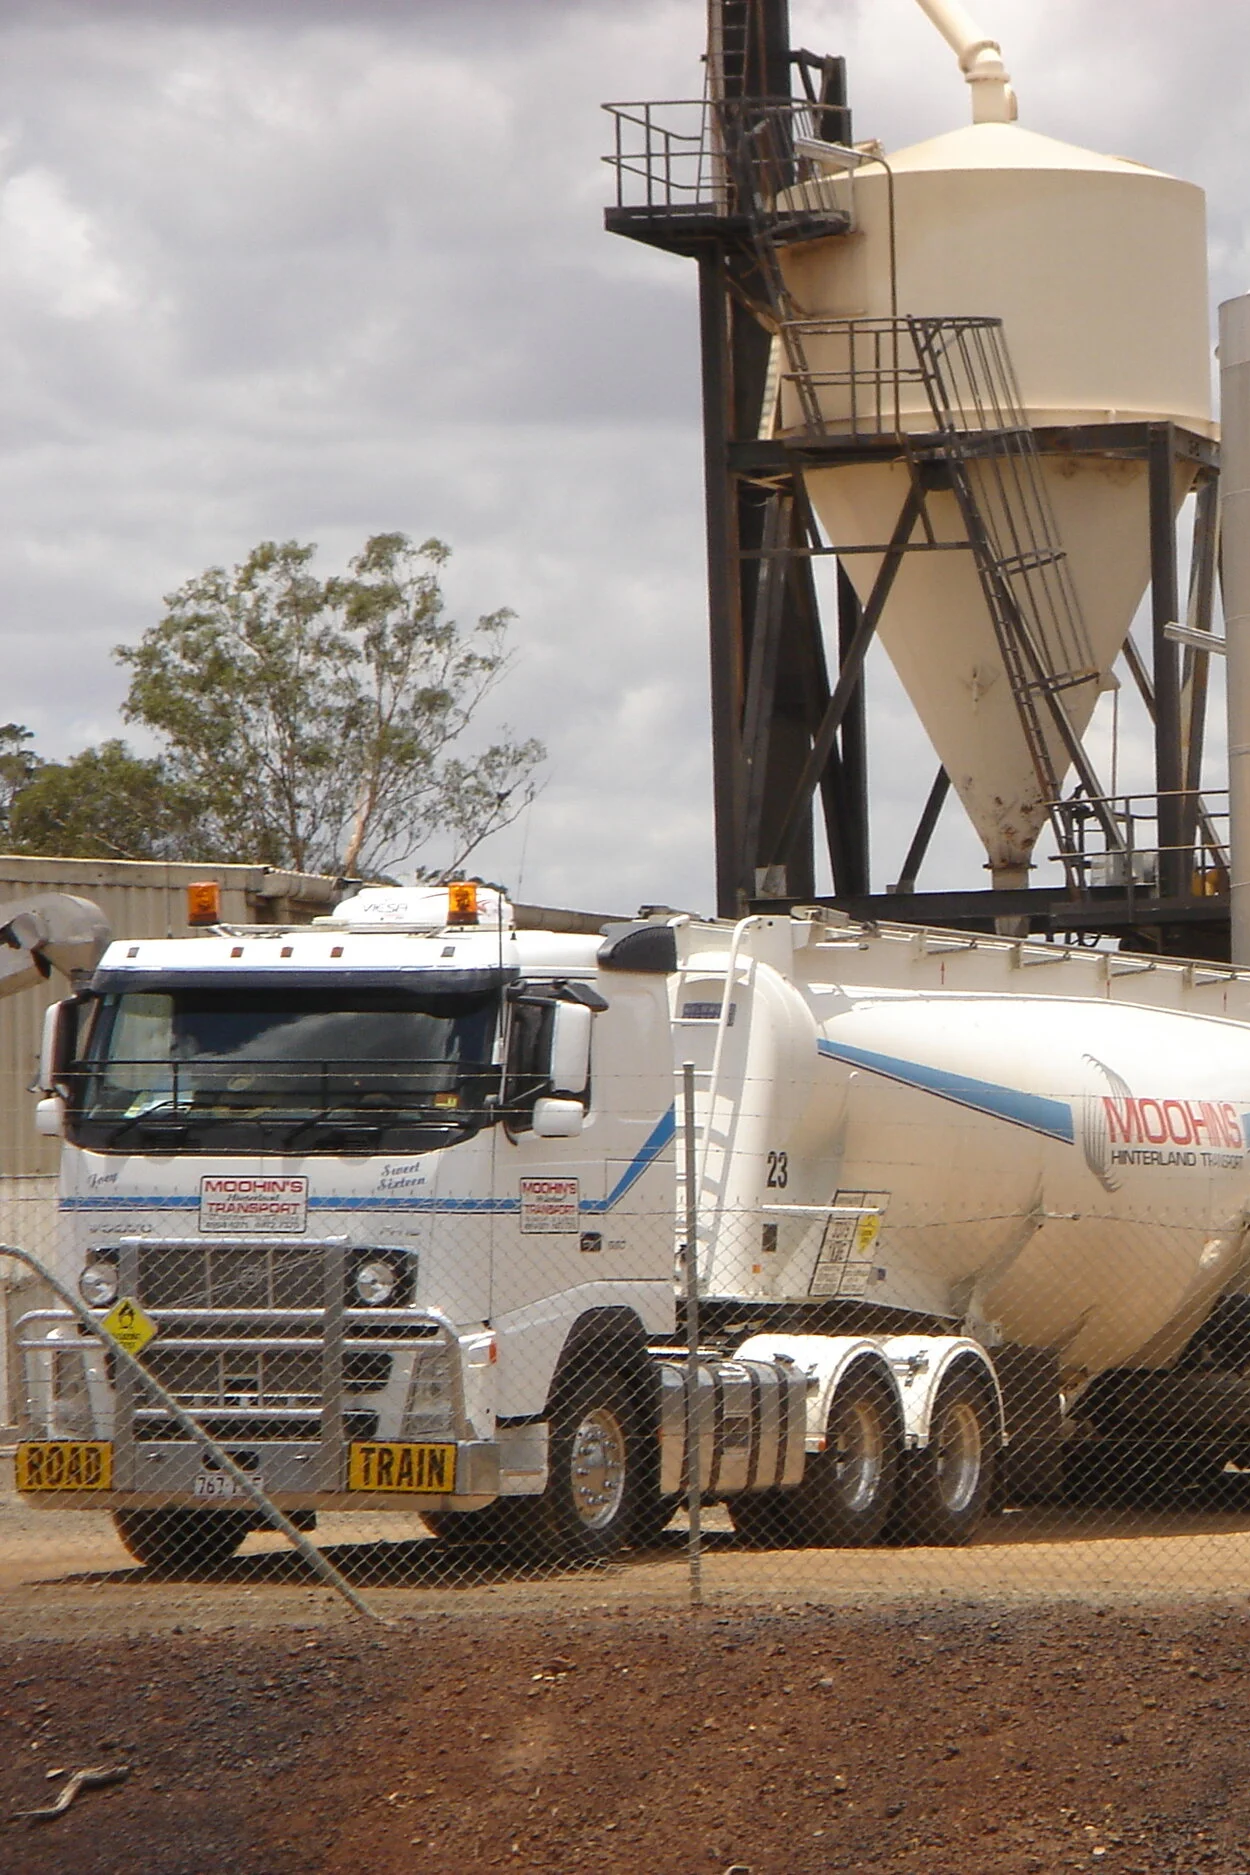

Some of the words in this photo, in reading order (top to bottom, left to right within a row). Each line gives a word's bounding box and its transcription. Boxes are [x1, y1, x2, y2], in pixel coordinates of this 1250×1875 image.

[767, 1151, 788, 1188] 23
[1112, 1151, 1197, 1167] HINTERLAND
[205, 1181, 304, 1193] MOOHIN'S
[207, 1203, 301, 1214] TRANSPORT
[27, 1446, 101, 1486] ROAD
[360, 1447, 446, 1487] TRAIN
